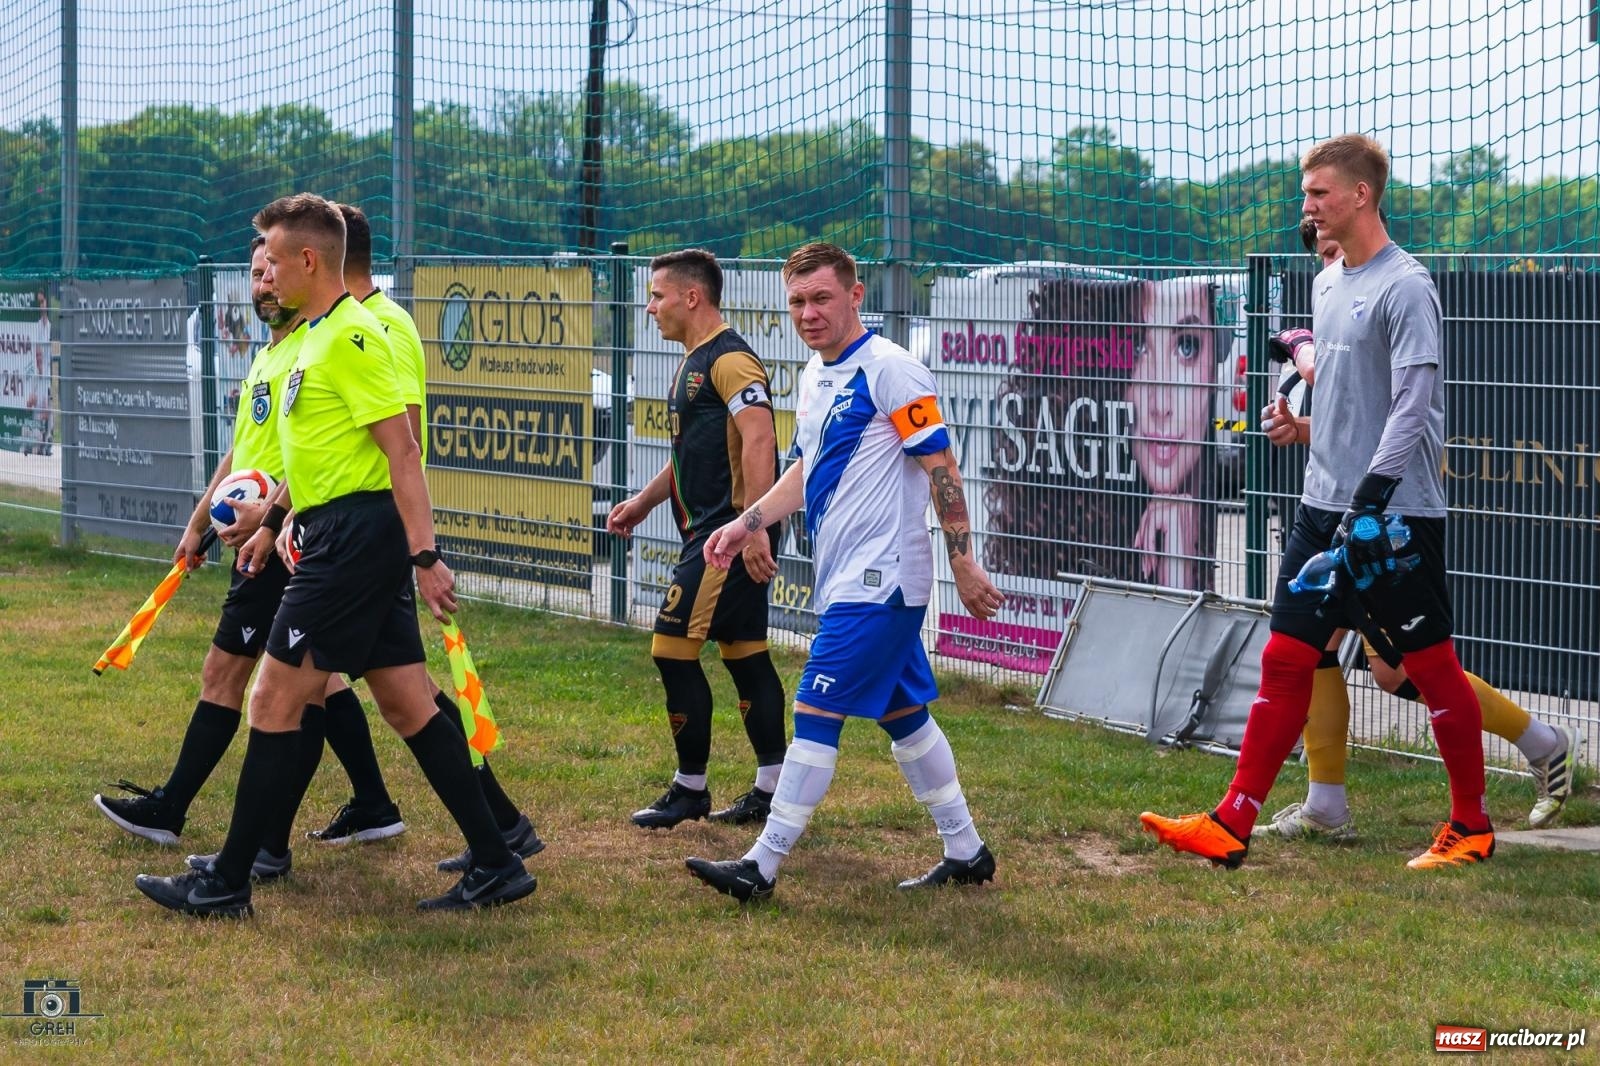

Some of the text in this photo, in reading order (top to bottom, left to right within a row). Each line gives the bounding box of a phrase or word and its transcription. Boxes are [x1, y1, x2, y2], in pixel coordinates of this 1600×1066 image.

[479, 290, 564, 348] GLOB
[941, 320, 1133, 377] salon fryzjerski
[480, 356, 514, 373] Mateusz
[3, 370, 25, 396] 24h
[741, 387, 758, 405] C
[908, 403, 928, 428] C
[432, 403, 578, 468] GEODEZJA
[1445, 436, 1600, 488] CLINI
[667, 583, 683, 613] 9
